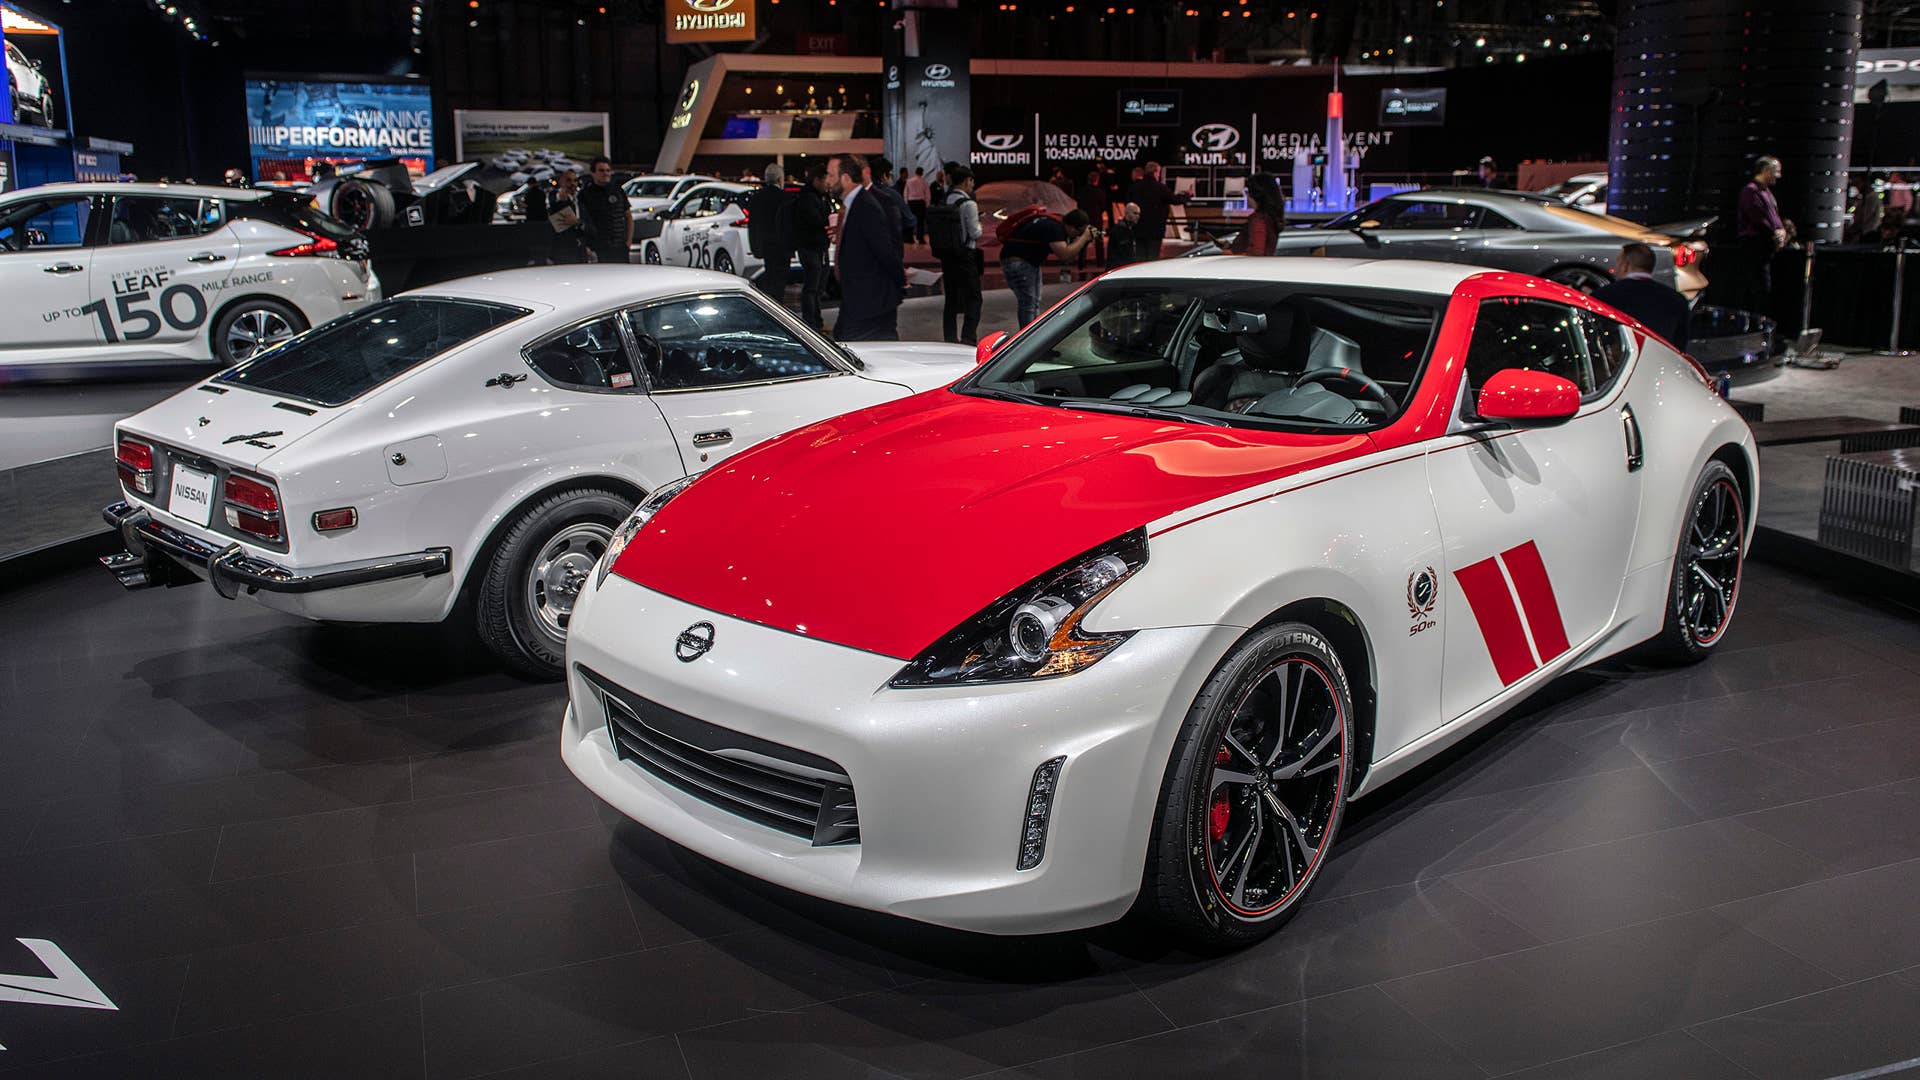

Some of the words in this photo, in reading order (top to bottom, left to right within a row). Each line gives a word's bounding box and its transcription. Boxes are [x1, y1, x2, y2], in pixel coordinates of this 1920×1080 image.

[675, 12, 746, 31] HYUNDAI
[808, 37, 835, 50] EXIT
[920, 80, 956, 88] HYUNDAI
[354, 110, 431, 128] WINNING
[274, 126, 432, 147] PERFORMANCE
[1045, 134, 1099, 147] MEDIA
[1105, 134, 1160, 147] EVENT
[1262, 133, 1321, 146] MEDIA
[970, 152, 1031, 164] HYUNDAI
[1044, 148, 1096, 160] 10:45AM
[1097, 148, 1139, 160] TODAY
[133, 265, 167, 275] NISSAN
[42, 312, 62, 323] UP
[63, 307, 81, 319] TO
[81, 283, 208, 344] 150
[201, 277, 231, 292] MILE
[232, 271, 274, 287] RANGE
[174, 483, 208, 505] NISSAN
[1408, 620, 1437, 637] 50th
